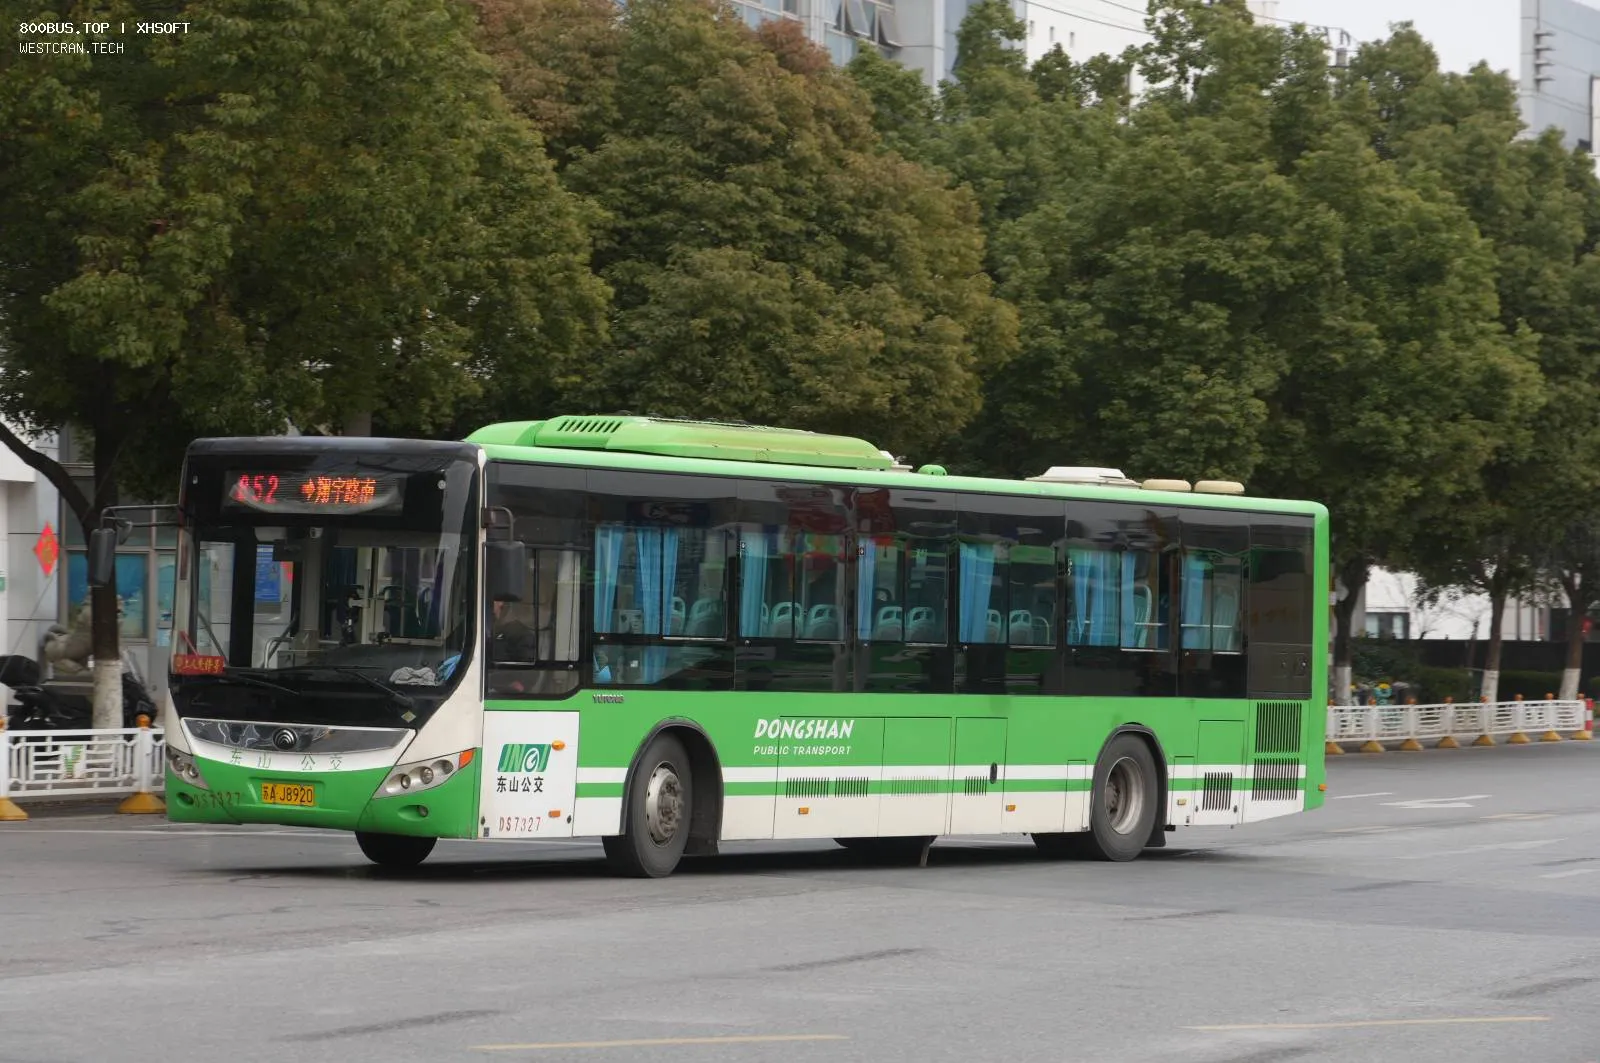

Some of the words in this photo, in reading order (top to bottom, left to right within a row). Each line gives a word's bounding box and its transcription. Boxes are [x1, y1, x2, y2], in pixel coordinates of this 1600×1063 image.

[754, 718, 855, 739] DONGSHAN
[753, 745, 789, 756] PUBLIC
[793, 745, 852, 756] TRANSPORT
[496, 775, 545, 793] 东山公交
[499, 816, 542, 833] DS7327
